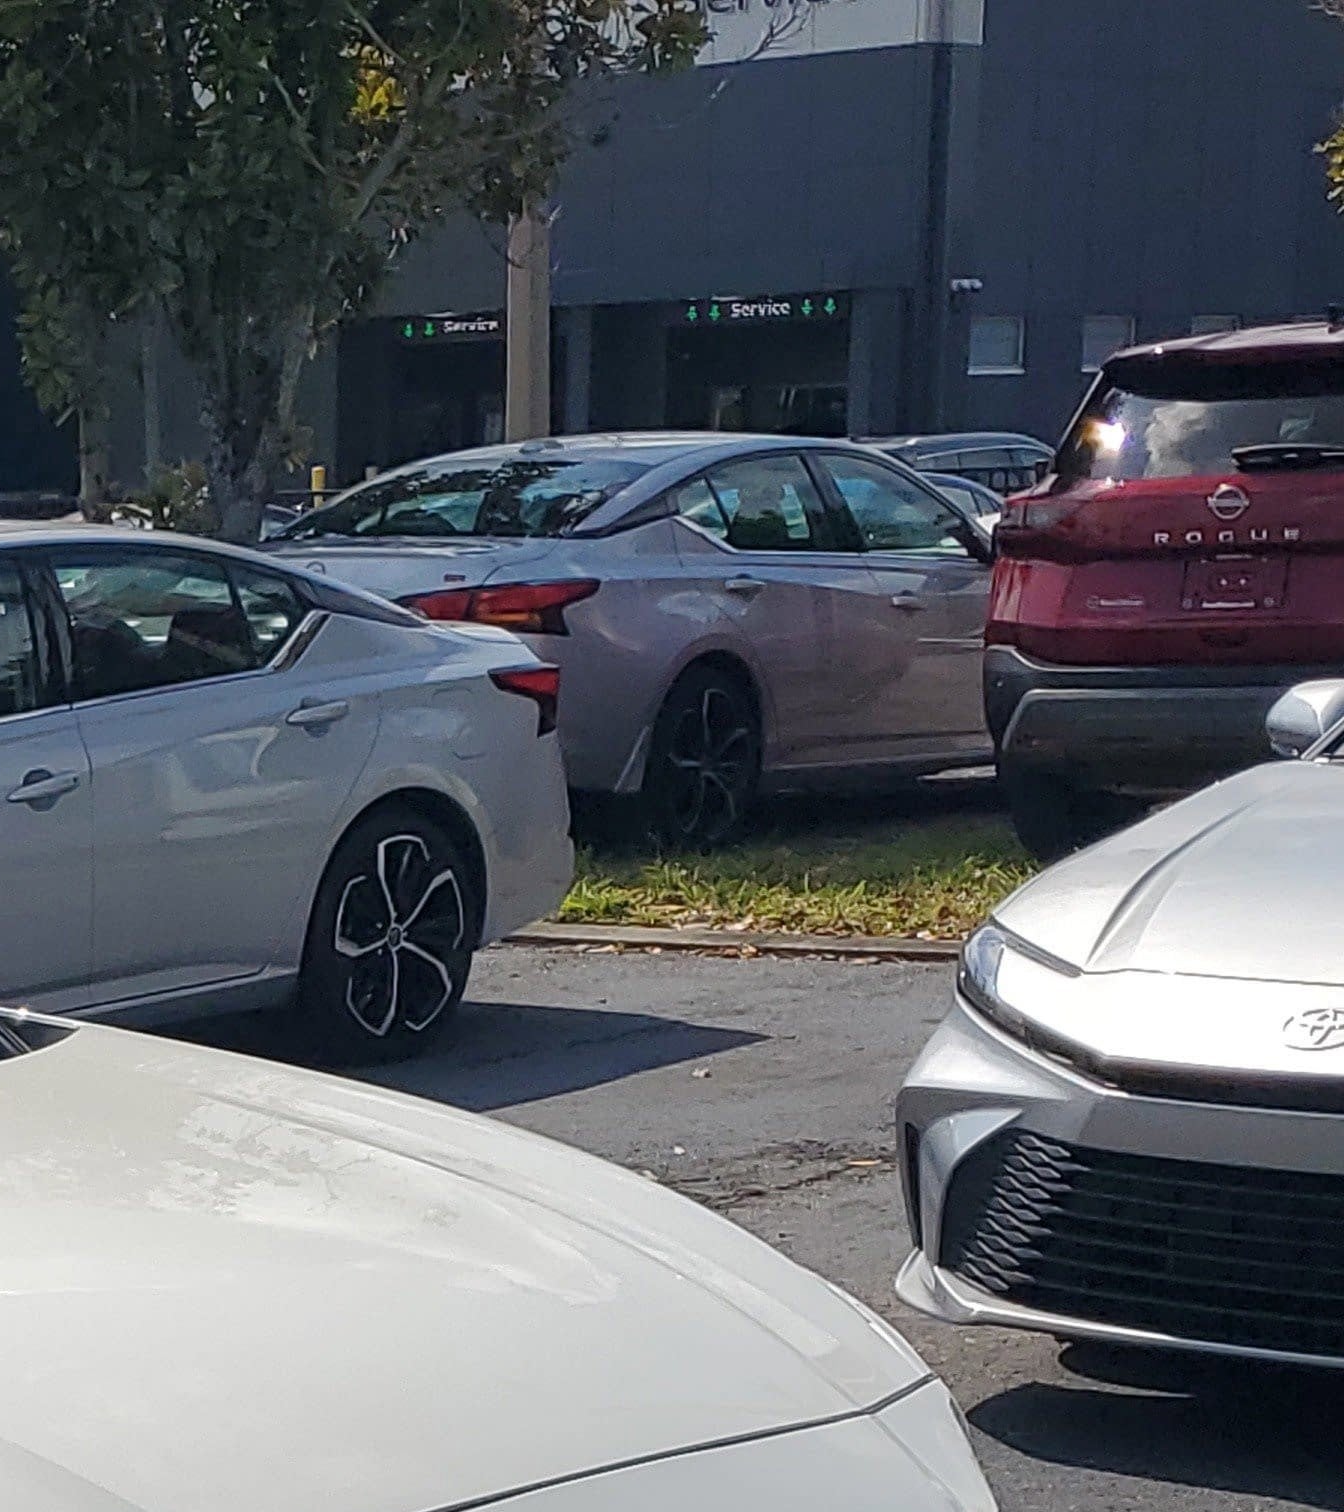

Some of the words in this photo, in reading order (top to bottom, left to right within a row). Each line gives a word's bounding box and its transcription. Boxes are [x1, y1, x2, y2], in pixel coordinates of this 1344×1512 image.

[731, 298, 791, 318] Service
[442, 316, 500, 334] Service
[1153, 527, 1300, 545] ROGUE
